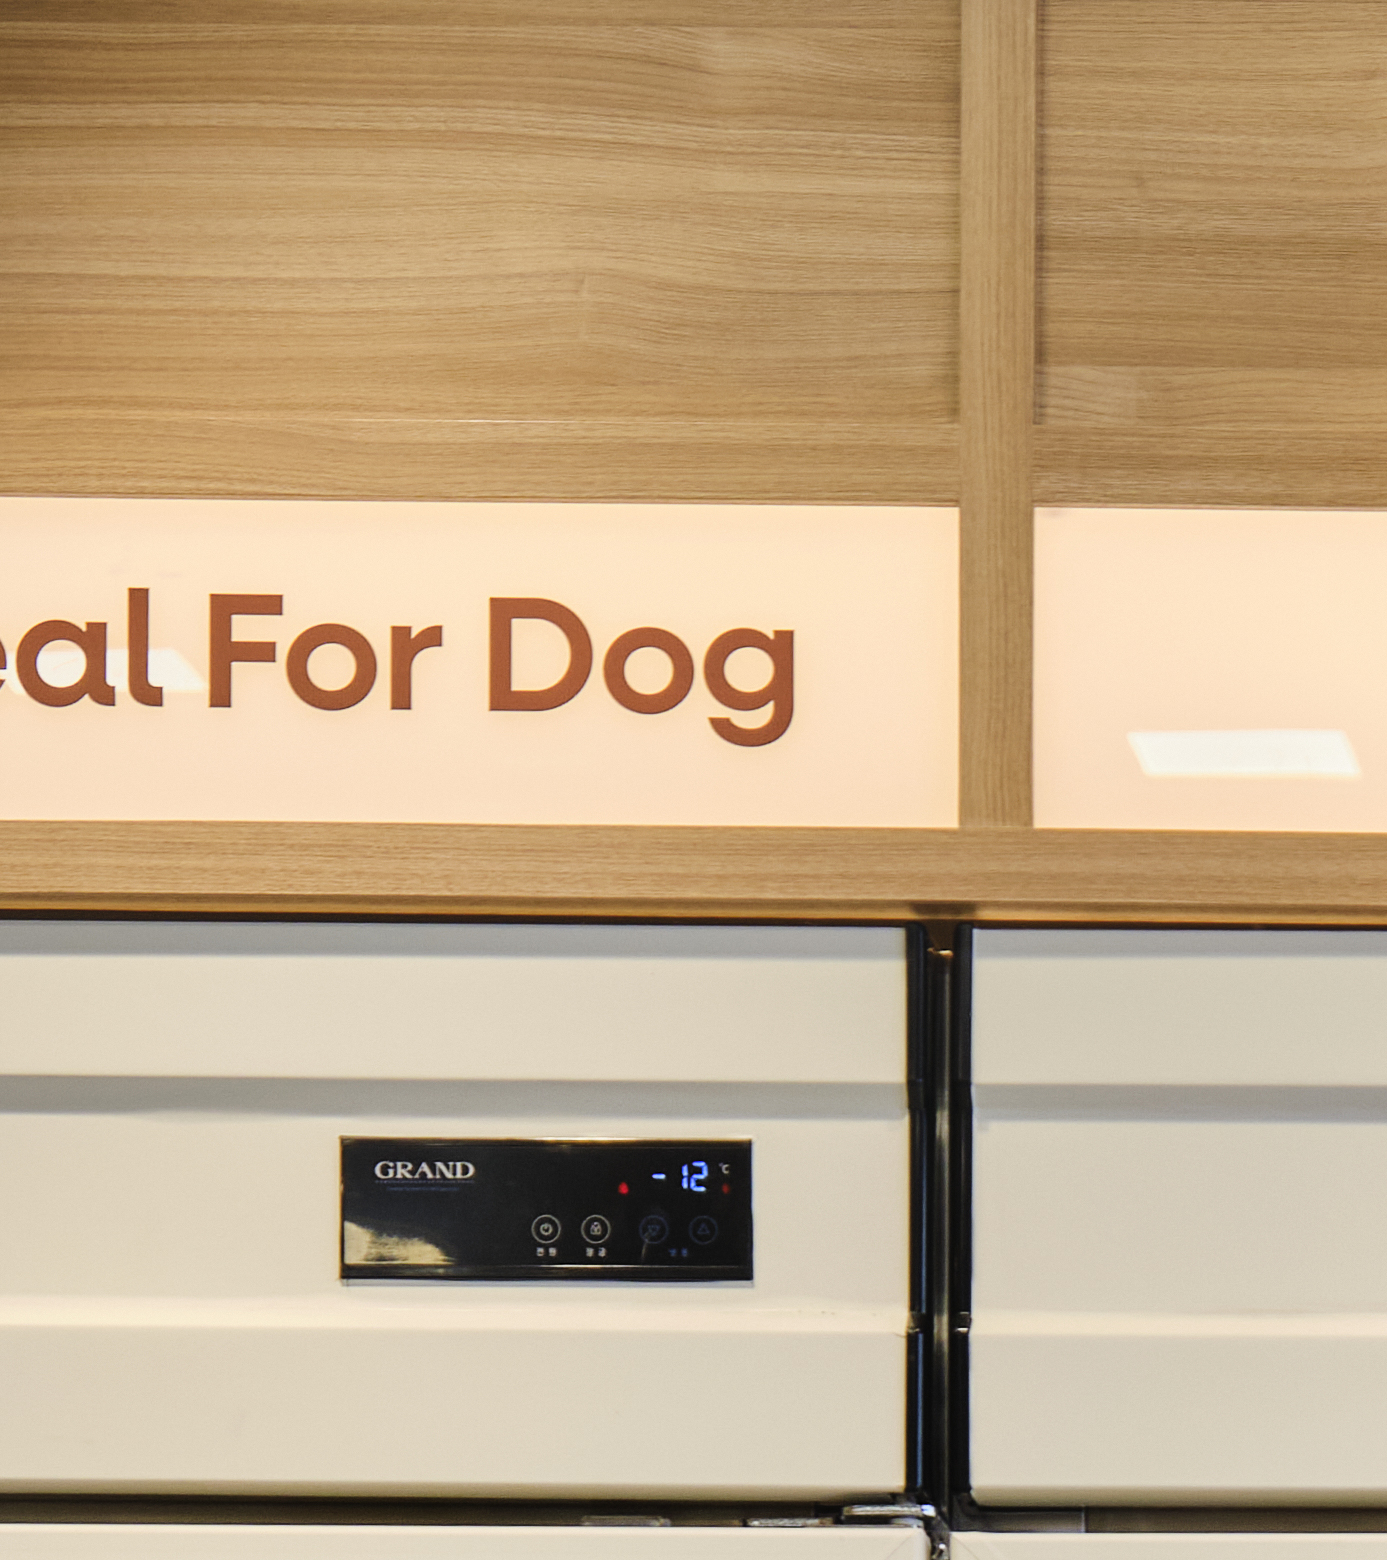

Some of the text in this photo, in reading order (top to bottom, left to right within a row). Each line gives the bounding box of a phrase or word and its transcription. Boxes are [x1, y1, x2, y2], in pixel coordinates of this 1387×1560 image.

[0, 587, 795, 747] al For Dog
[374, 1160, 475, 1179] GRAND
